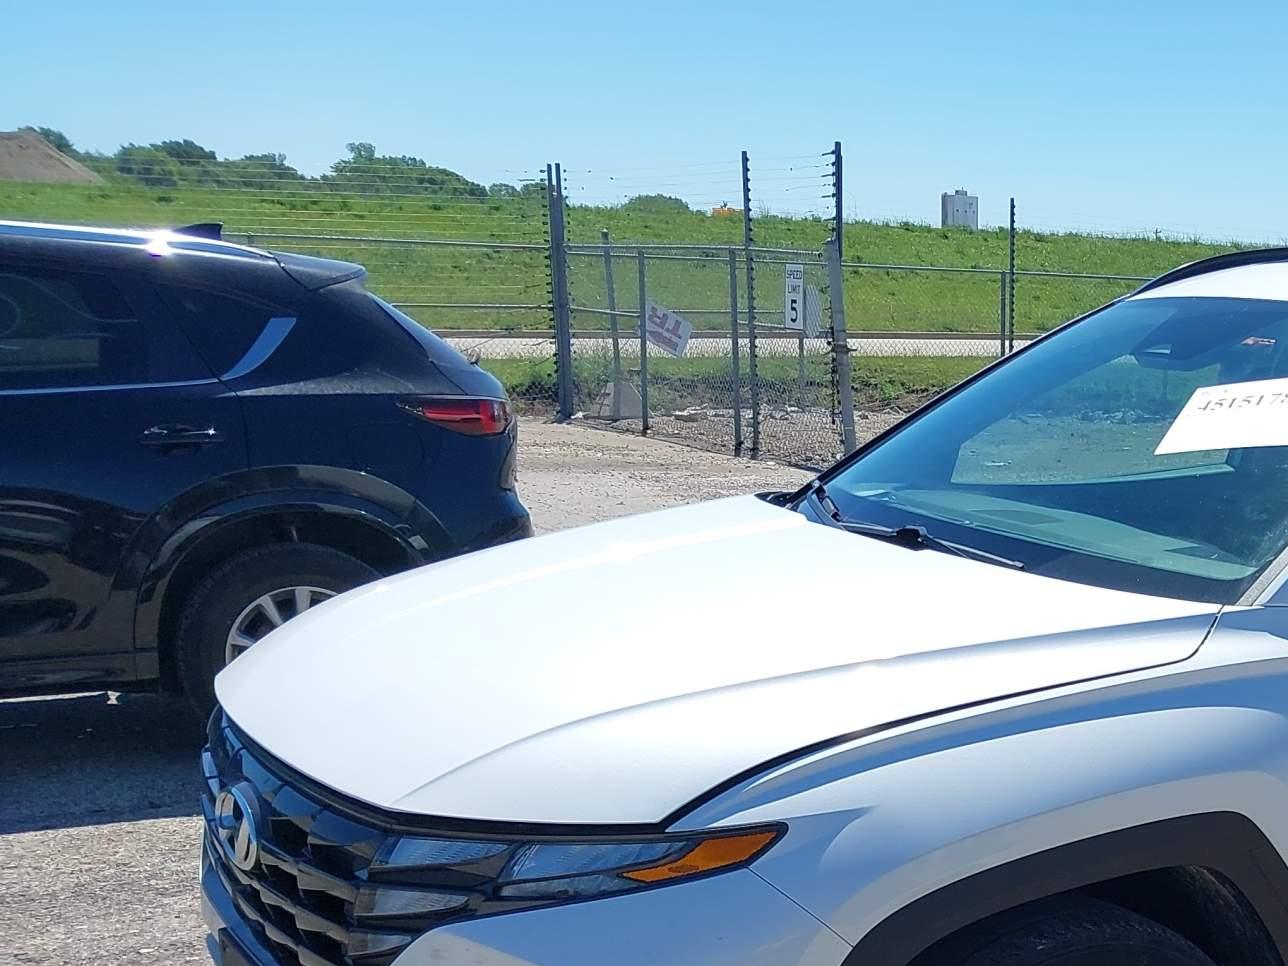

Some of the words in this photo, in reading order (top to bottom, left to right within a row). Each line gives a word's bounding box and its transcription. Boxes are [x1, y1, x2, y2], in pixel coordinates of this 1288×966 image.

[786, 269, 802, 280] SPEED
[787, 284, 801, 295] LIMIT
[790, 298, 798, 323] 5
